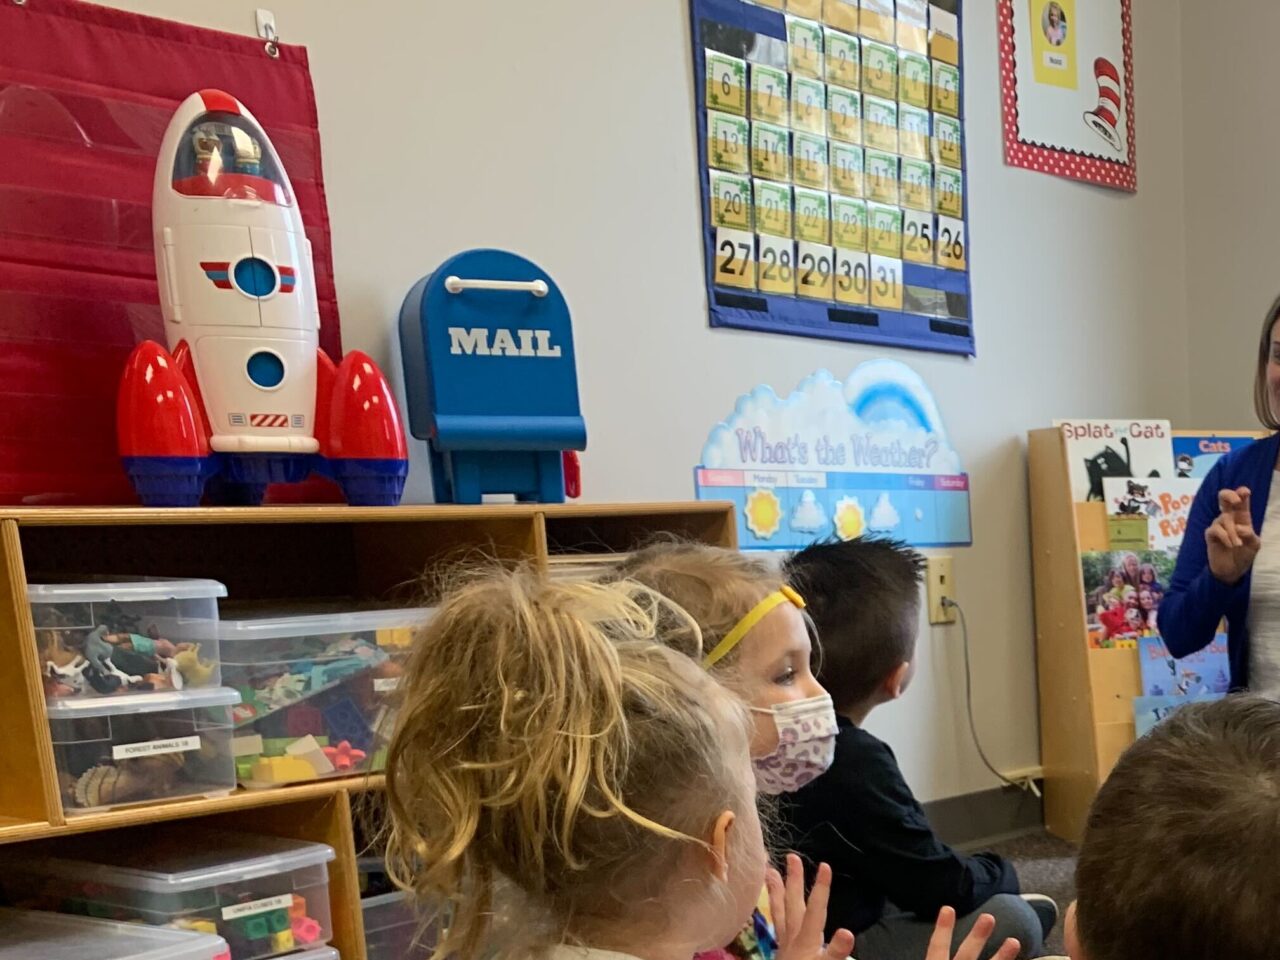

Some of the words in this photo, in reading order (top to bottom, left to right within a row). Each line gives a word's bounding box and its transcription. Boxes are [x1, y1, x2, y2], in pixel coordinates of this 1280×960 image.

[802, 37, 809, 60] 1
[838, 48, 847, 71] 2
[875, 59, 884, 81] 3
[911, 69, 919, 91] 4
[943, 79, 950, 100] 5
[721, 73, 732, 96] 6
[766, 84, 774, 107] 7
[805, 95, 813, 116] 8
[840, 104, 847, 125] 9
[942, 131, 954, 151] 12
[722, 130, 739, 155] 13
[763, 139, 779, 164] 14
[805, 149, 820, 172] 15
[841, 159, 855, 181] 16
[875, 167, 888, 188] 17
[910, 174, 923, 195] 18
[942, 181, 954, 203] 19
[724, 191, 741, 215] 20
[764, 198, 779, 222] 21
[803, 205, 819, 229] 22
[842, 212, 858, 235] 23
[879, 219, 896, 243] 24
[906, 221, 931, 253] 25
[941, 228, 963, 260] 26
[719, 239, 752, 277] 27
[762, 247, 792, 283] 28
[801, 253, 832, 288] 29
[838, 260, 867, 295] 30
[877, 266, 897, 299] 31
[448, 327, 562, 357] MAIL
[735, 426, 808, 466] What's
[815, 434, 846, 466] the
[851, 432, 939, 469] Weather?
[1060, 423, 1114, 440] Splat
[1129, 422, 1165, 439] Cat
[1199, 440, 1231, 454] Cats
[125, 745, 150, 754] FOREST
[152, 742, 179, 750] ANIMALS
